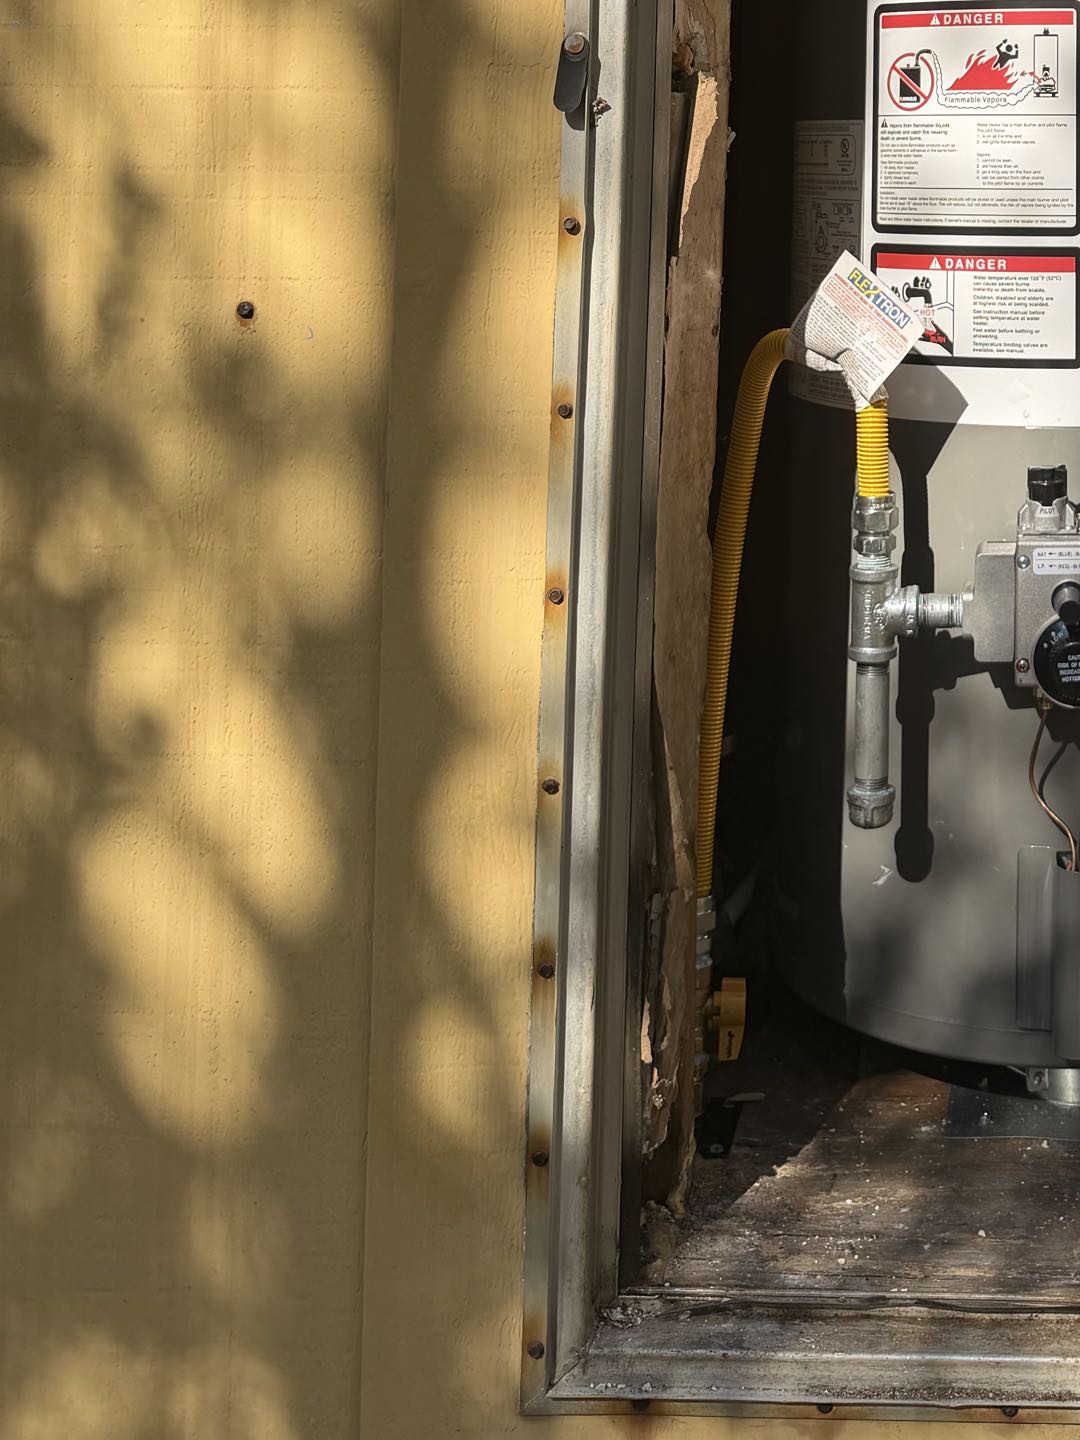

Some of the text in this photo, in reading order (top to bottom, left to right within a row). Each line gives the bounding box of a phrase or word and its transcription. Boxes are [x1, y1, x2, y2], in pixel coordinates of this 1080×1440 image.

[944, 13, 1003, 25] DANGER
[982, 96, 1007, 104] Vapors
[945, 258, 1007, 270] DANGER
[848, 268, 910, 329] FLEXTRON
[1050, 631, 1064, 645] LOW
